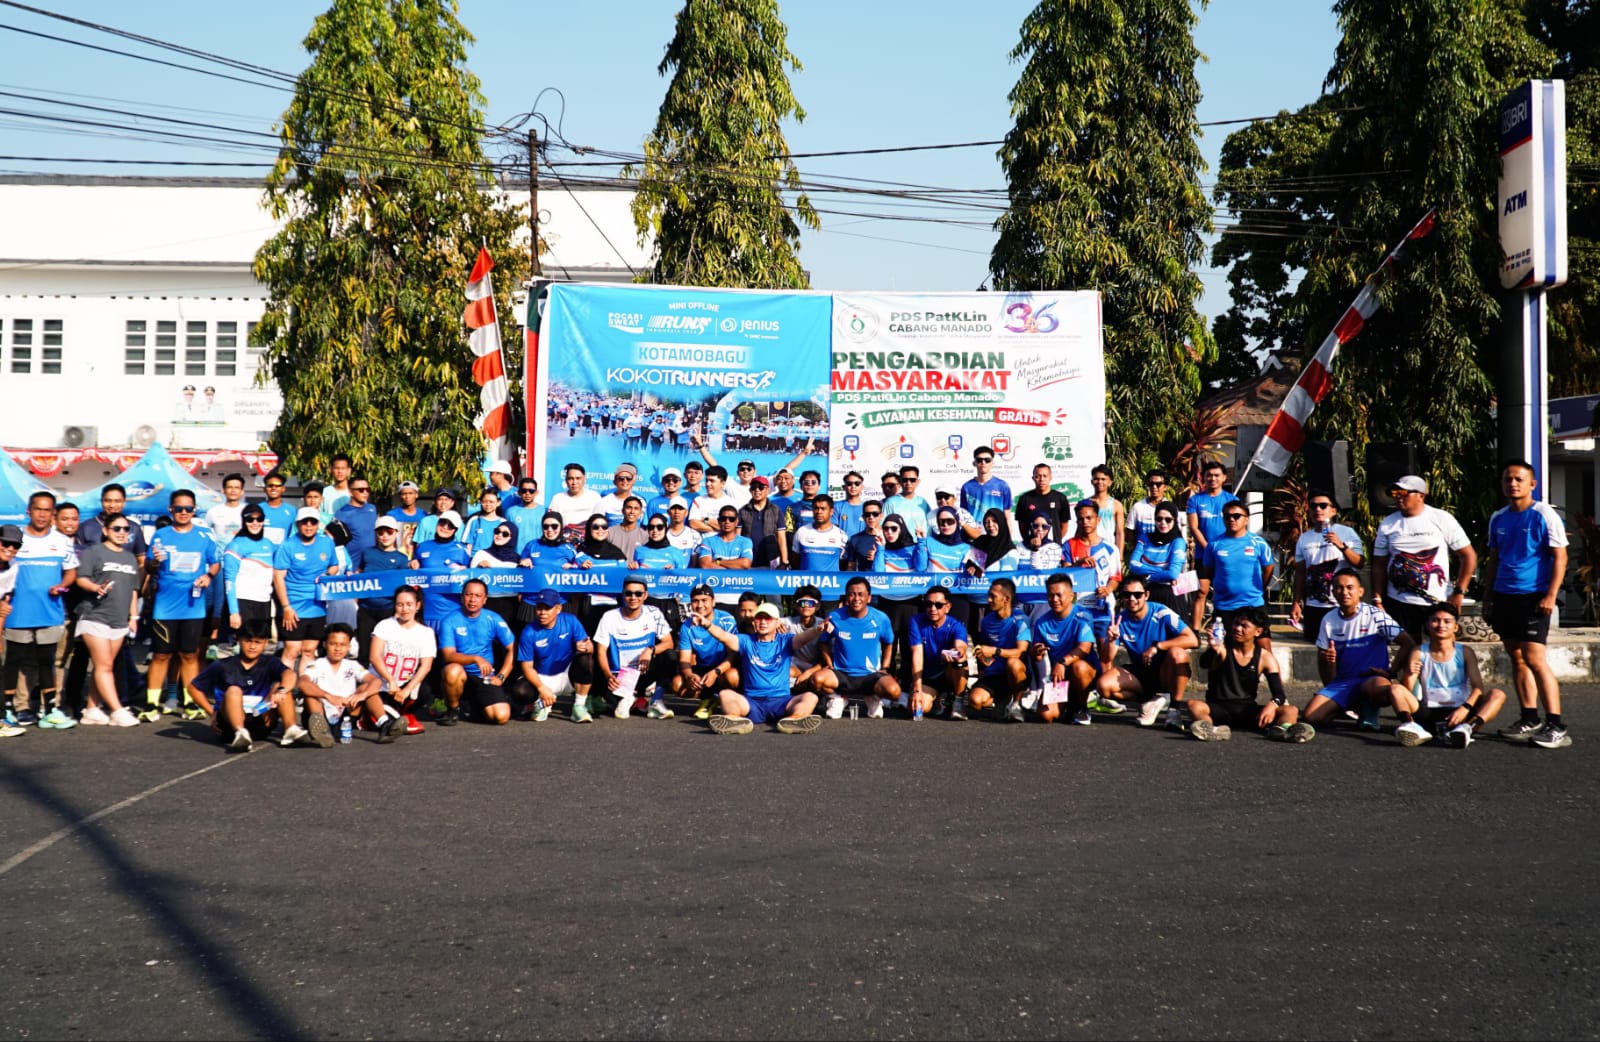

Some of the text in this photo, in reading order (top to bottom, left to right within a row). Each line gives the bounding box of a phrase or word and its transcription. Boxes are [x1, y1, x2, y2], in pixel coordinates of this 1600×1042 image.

[1511, 100, 1528, 127] BRI
[1504, 190, 1527, 216] ATM
[668, 302, 720, 312] MINI OFFLINE
[608, 312, 643, 320] POCARI
[608, 319, 640, 327] SWEAT
[890, 310, 987, 322] PDS PatKLin
[1004, 300, 1060, 334] 36
[888, 323, 993, 333] CABANG MANADO
[638, 346, 747, 364] KOTAMOBAGU
[831, 351, 1005, 370] PENGABDIAN
[606, 367, 757, 389] KOKOTRUNNERS
[831, 370, 1012, 391] MASYARAKAT
[837, 392, 998, 403] PDS PatKLin Cabang Manado
[868, 407, 1043, 425] LAYANAN KESEHATAN GRATIS
[319, 578, 382, 594] VIRTUAL
[544, 572, 608, 586] VIRTUAL
[776, 574, 840, 589] VIRTUAL
[1011, 573, 1078, 587] VIRTL
